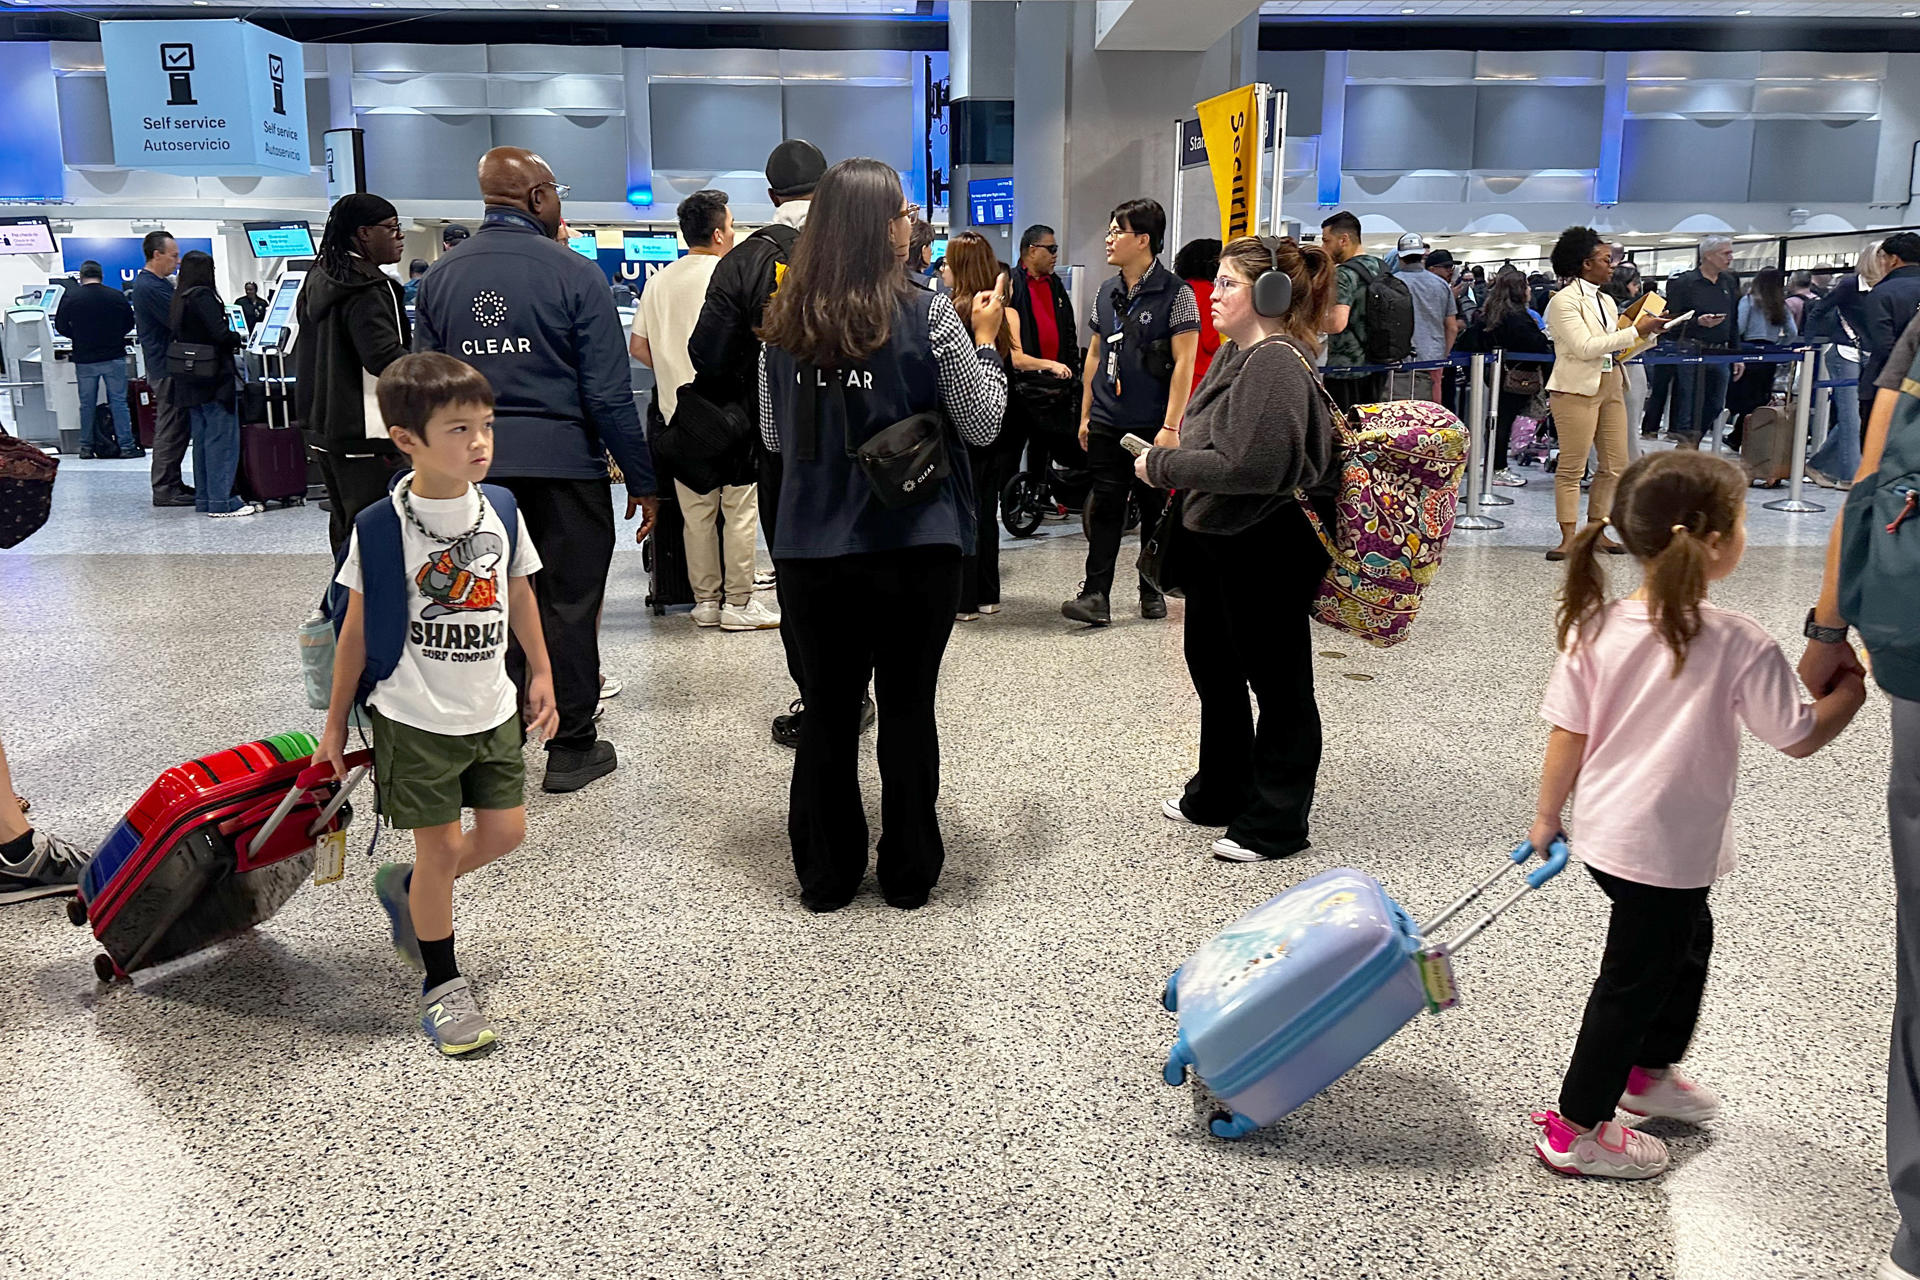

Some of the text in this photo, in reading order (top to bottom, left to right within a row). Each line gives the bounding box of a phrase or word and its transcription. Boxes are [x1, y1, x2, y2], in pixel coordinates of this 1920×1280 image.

[143, 116, 226, 130] Self service
[263, 120, 298, 141] Self service
[143, 138, 230, 152] Autoservicio
[265, 142, 300, 161] Autoservicio
[1229, 111, 1248, 236] Securit
[462, 337, 531, 355] CLEAR
[917, 463, 935, 483] CLEAR
[451, 649, 496, 663] COMPANY
